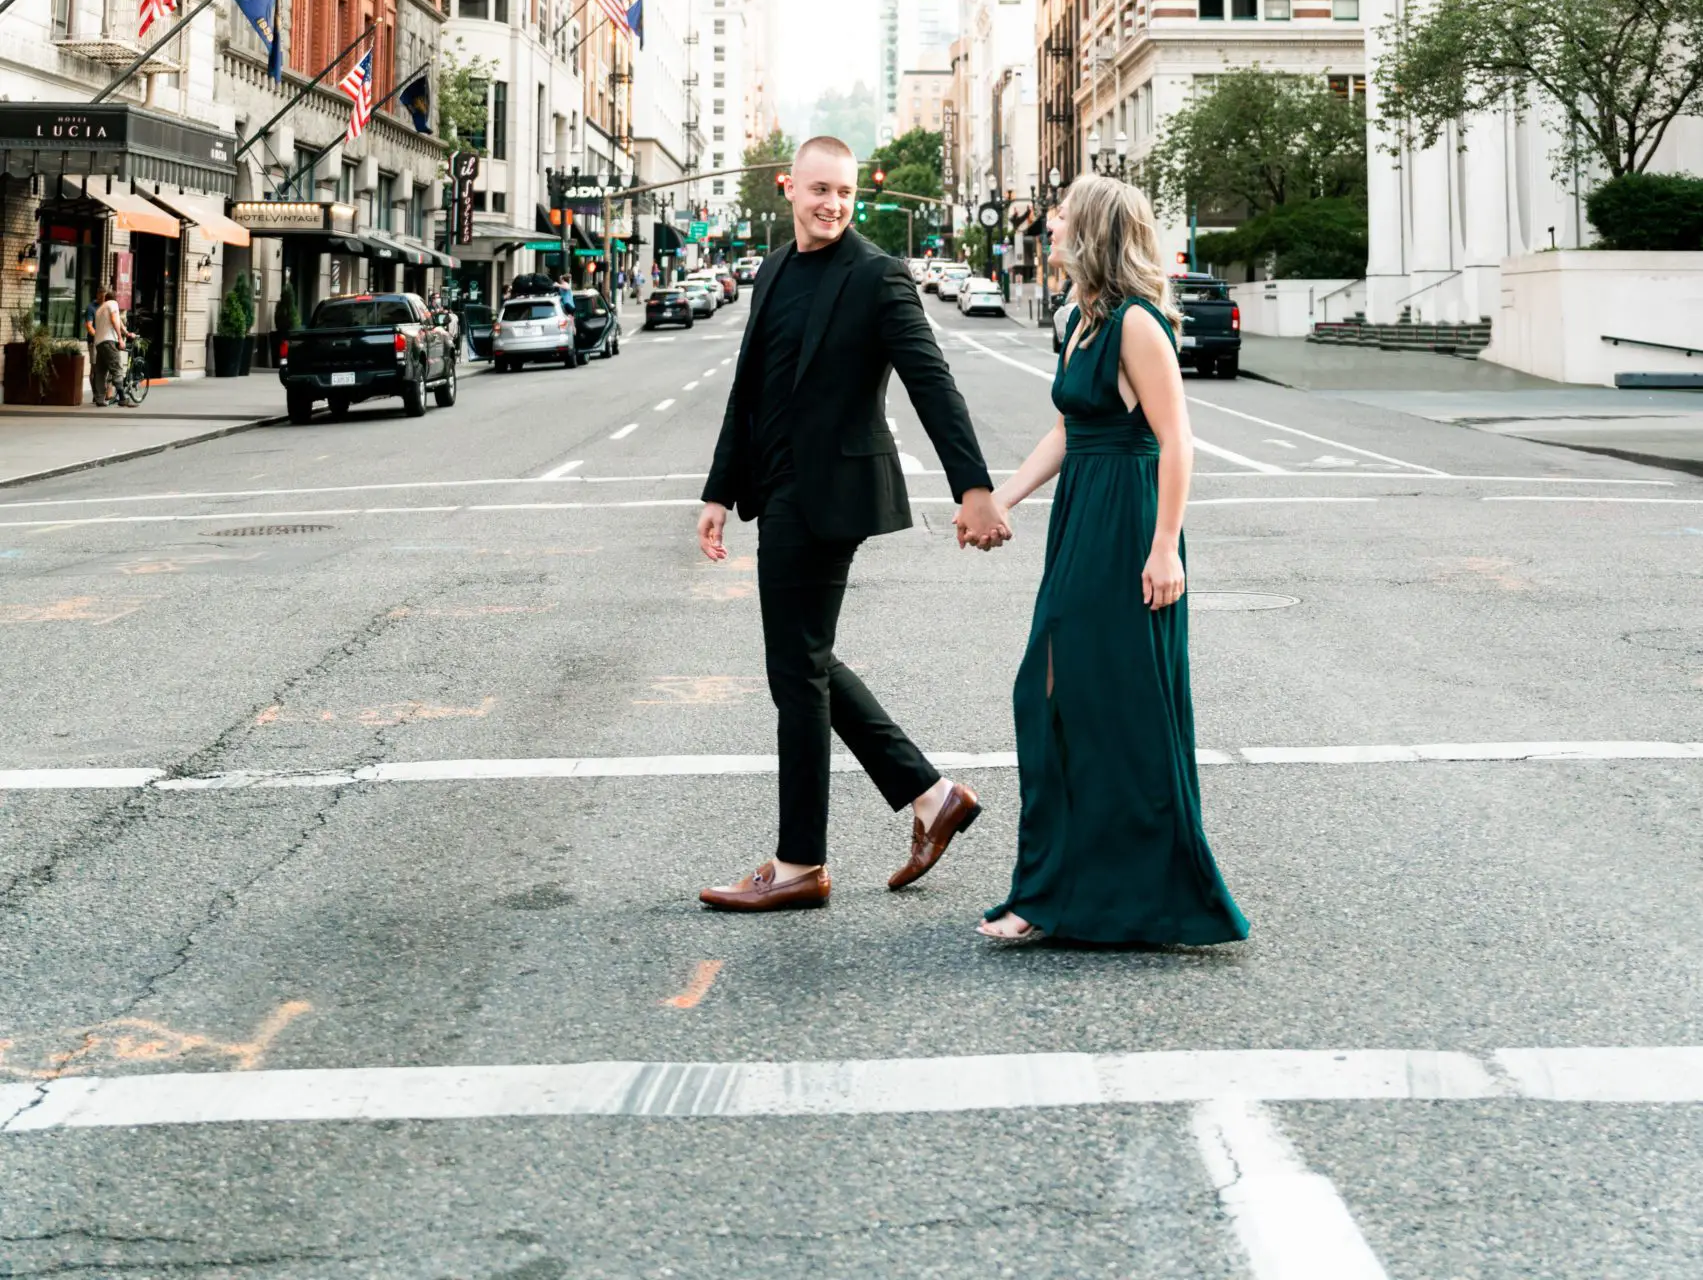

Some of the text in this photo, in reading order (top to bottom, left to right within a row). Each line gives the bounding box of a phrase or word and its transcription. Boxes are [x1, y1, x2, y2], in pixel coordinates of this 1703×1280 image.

[36, 125, 107, 138] LUCIA
[944, 105, 953, 185] NORDSTROM
[271, 214, 321, 223] VINTAGE
